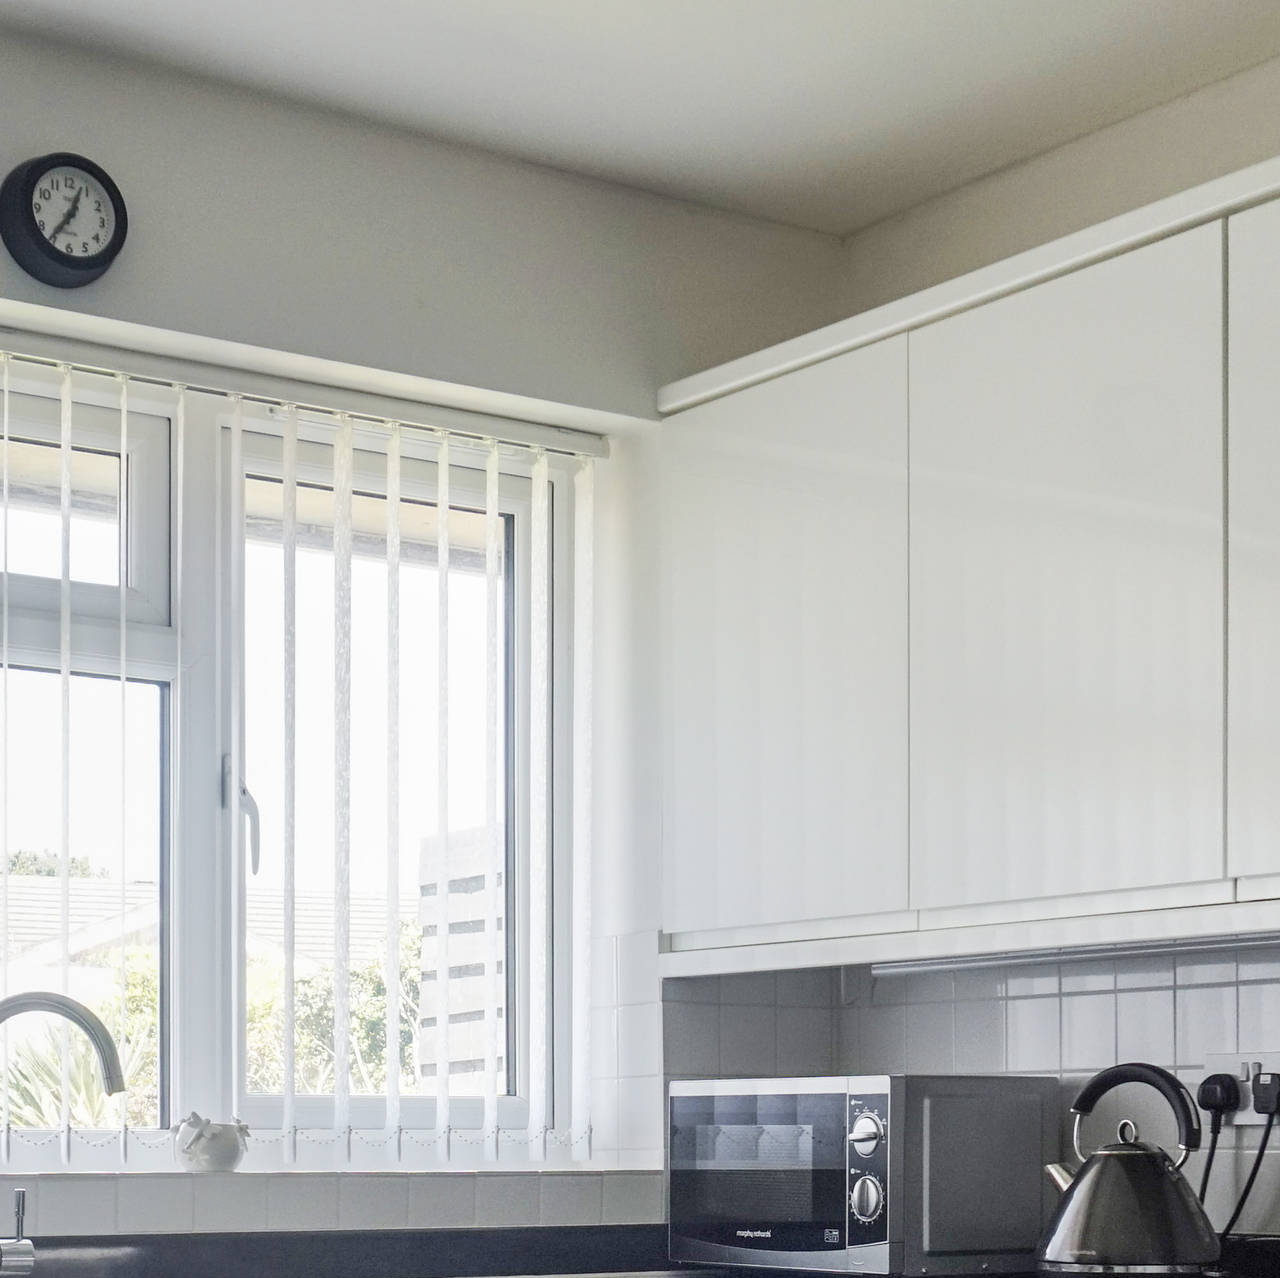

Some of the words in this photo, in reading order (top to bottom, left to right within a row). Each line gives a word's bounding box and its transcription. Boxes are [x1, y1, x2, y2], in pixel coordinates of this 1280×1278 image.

[51, 179, 59, 191] 11
[64, 176, 75, 189] 12
[39, 187, 51, 200] 10
[84, 186, 89, 197] 1
[33, 203, 41, 213] 9
[94, 201, 101, 212] 2
[38, 220, 45, 231] 8
[99, 216, 105, 228] 3
[91, 233, 99, 243] 4
[65, 243, 73, 254] 6
[81, 242, 88, 252] 5
